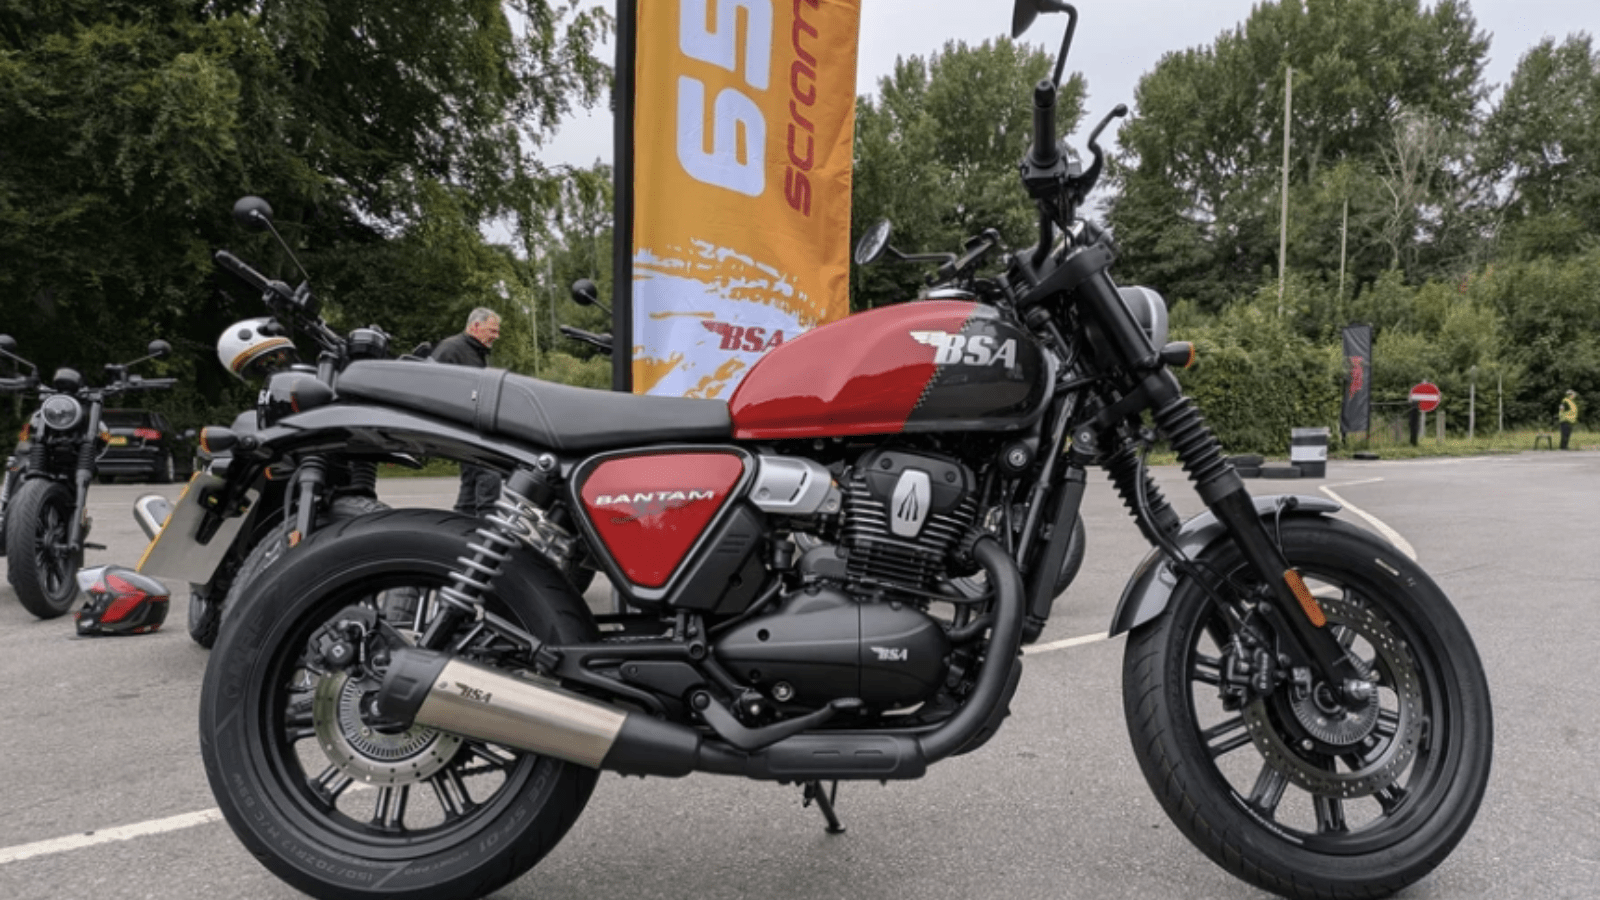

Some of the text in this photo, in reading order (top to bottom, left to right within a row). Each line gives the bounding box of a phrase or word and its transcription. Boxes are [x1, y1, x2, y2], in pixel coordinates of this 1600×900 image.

[702, 324, 784, 352] BSA
[909, 330, 1017, 368] BSA
[596, 490, 715, 505] BANTAM
[871, 646, 908, 661] BSA
[455, 682, 493, 703] BSA
